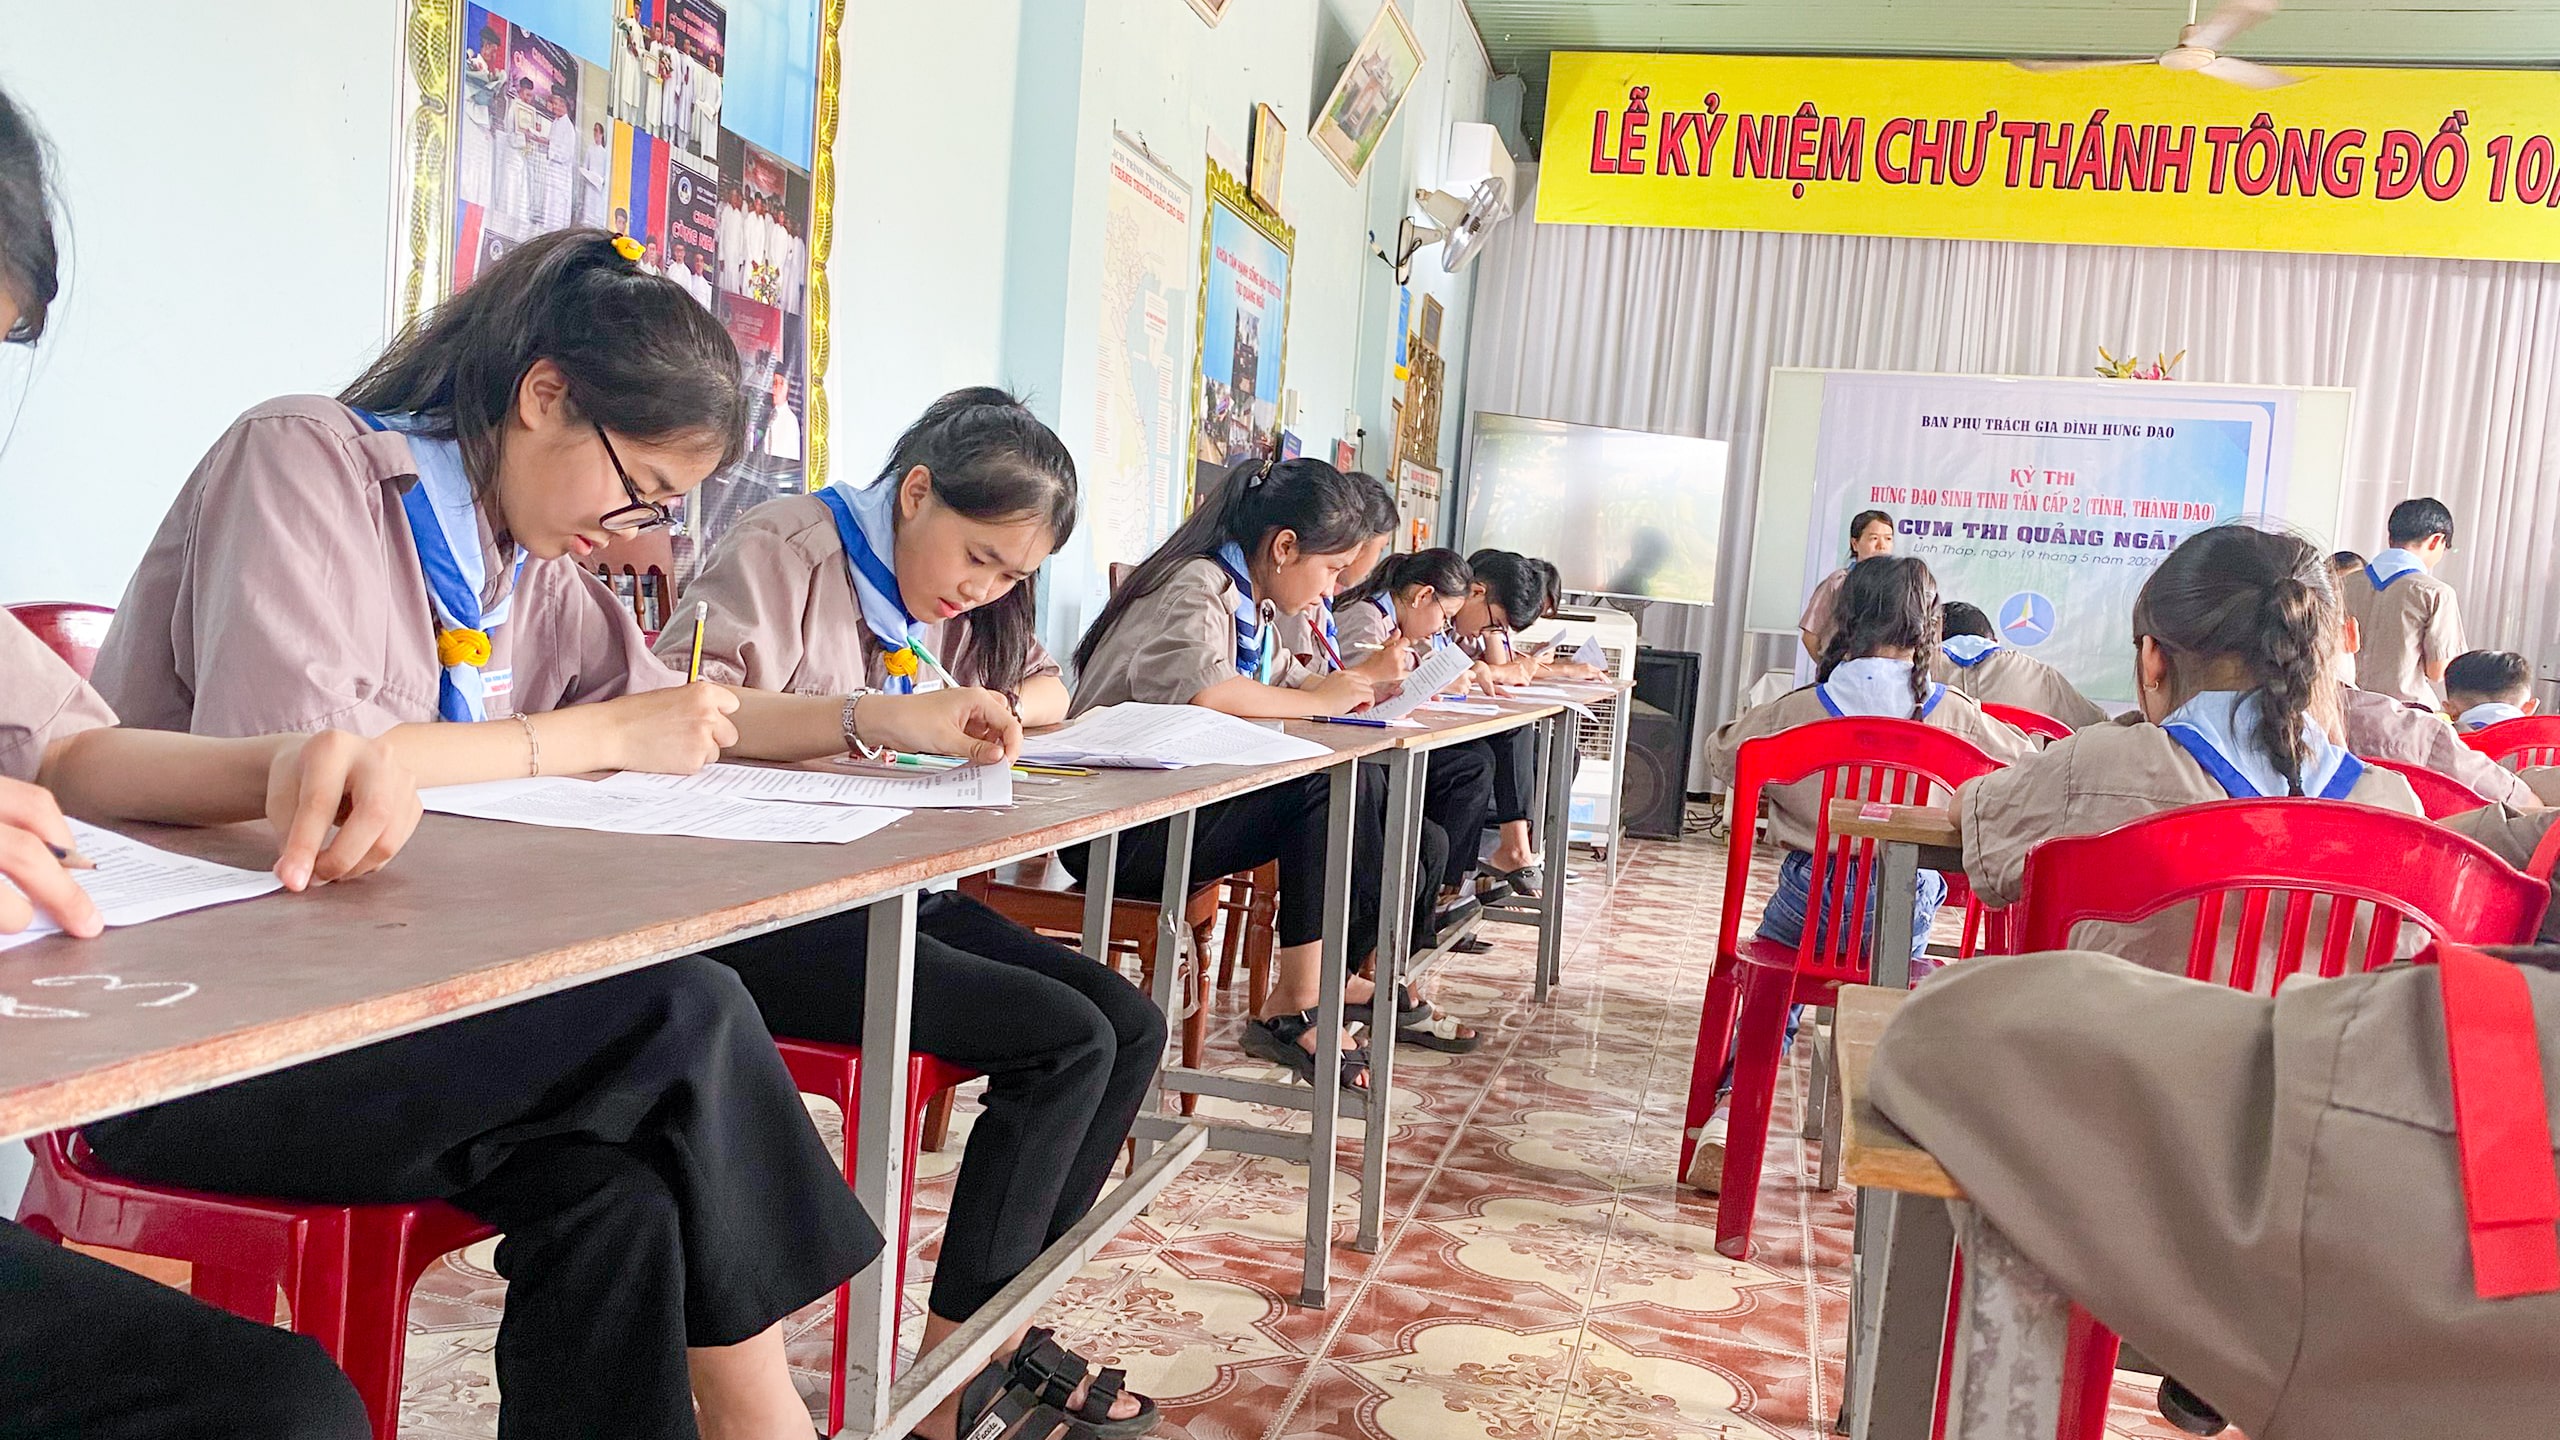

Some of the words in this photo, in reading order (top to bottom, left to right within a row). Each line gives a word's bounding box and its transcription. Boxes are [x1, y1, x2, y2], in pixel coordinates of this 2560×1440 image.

[1589, 86, 1650, 175] LỄ
[1656, 92, 1728, 177] KỶ
[1732, 102, 1865, 199] NIỆM
[1875, 110, 1999, 187] CHƯ
[2000, 109, 2196, 193] THÁNH
[2205, 112, 2367, 197] TÔNG
[2375, 110, 2470, 201] ĐỒ
[1921, 415, 1949, 428] BAN
[1952, 416, 1982, 431] PHỤ
[1985, 416, 2031, 432] TRÁCH
[2035, 420, 2058, 433] GIA
[2009, 465, 2036, 488] KỲ
[2043, 470, 2075, 486] THI
[1870, 486, 1907, 504] HƯNG
[1941, 490, 1973, 508] SINH
[1976, 491, 2009, 510] TINH
[2072, 497, 2080, 514] 2
[2132, 497, 2179, 519] THÀNH
[1898, 519, 1953, 540] CỤM
[1962, 522, 2009, 540] THI
[2017, 522, 2104, 547] QUẢNG
[2021, 548, 2035, 559] 19
[2038, 550, 2078, 564] tháng
[2080, 553, 2089, 563] 5
